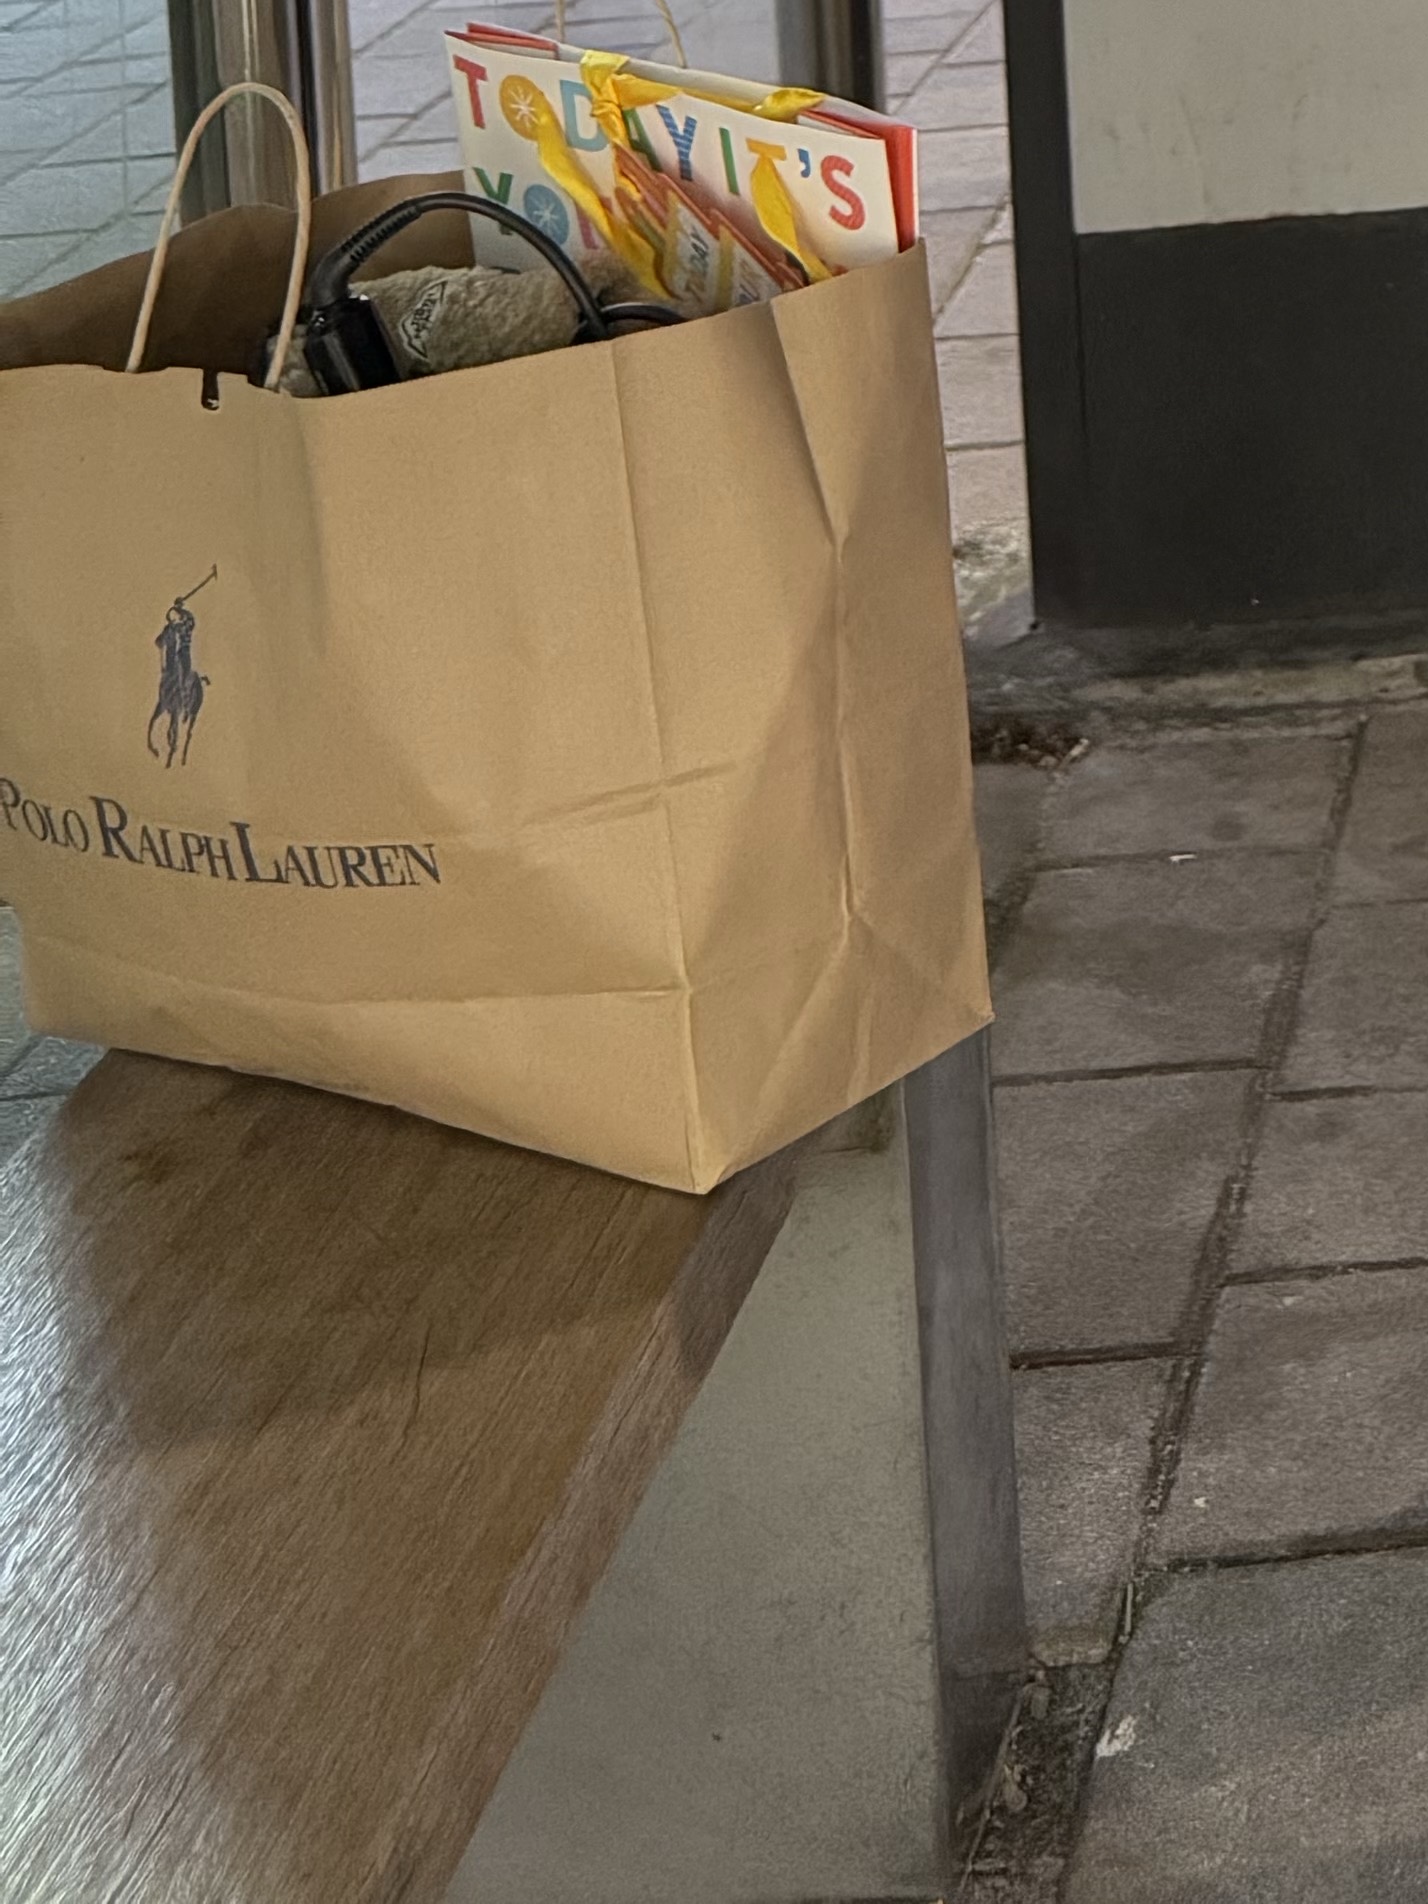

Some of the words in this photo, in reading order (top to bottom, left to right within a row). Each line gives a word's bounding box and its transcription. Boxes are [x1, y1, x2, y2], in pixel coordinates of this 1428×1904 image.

[452, 53, 699, 182] TODAY
[0, 776, 91, 853] POLO
[89, 795, 239, 882] RALPH
[229, 820, 442, 890] LAUREN
